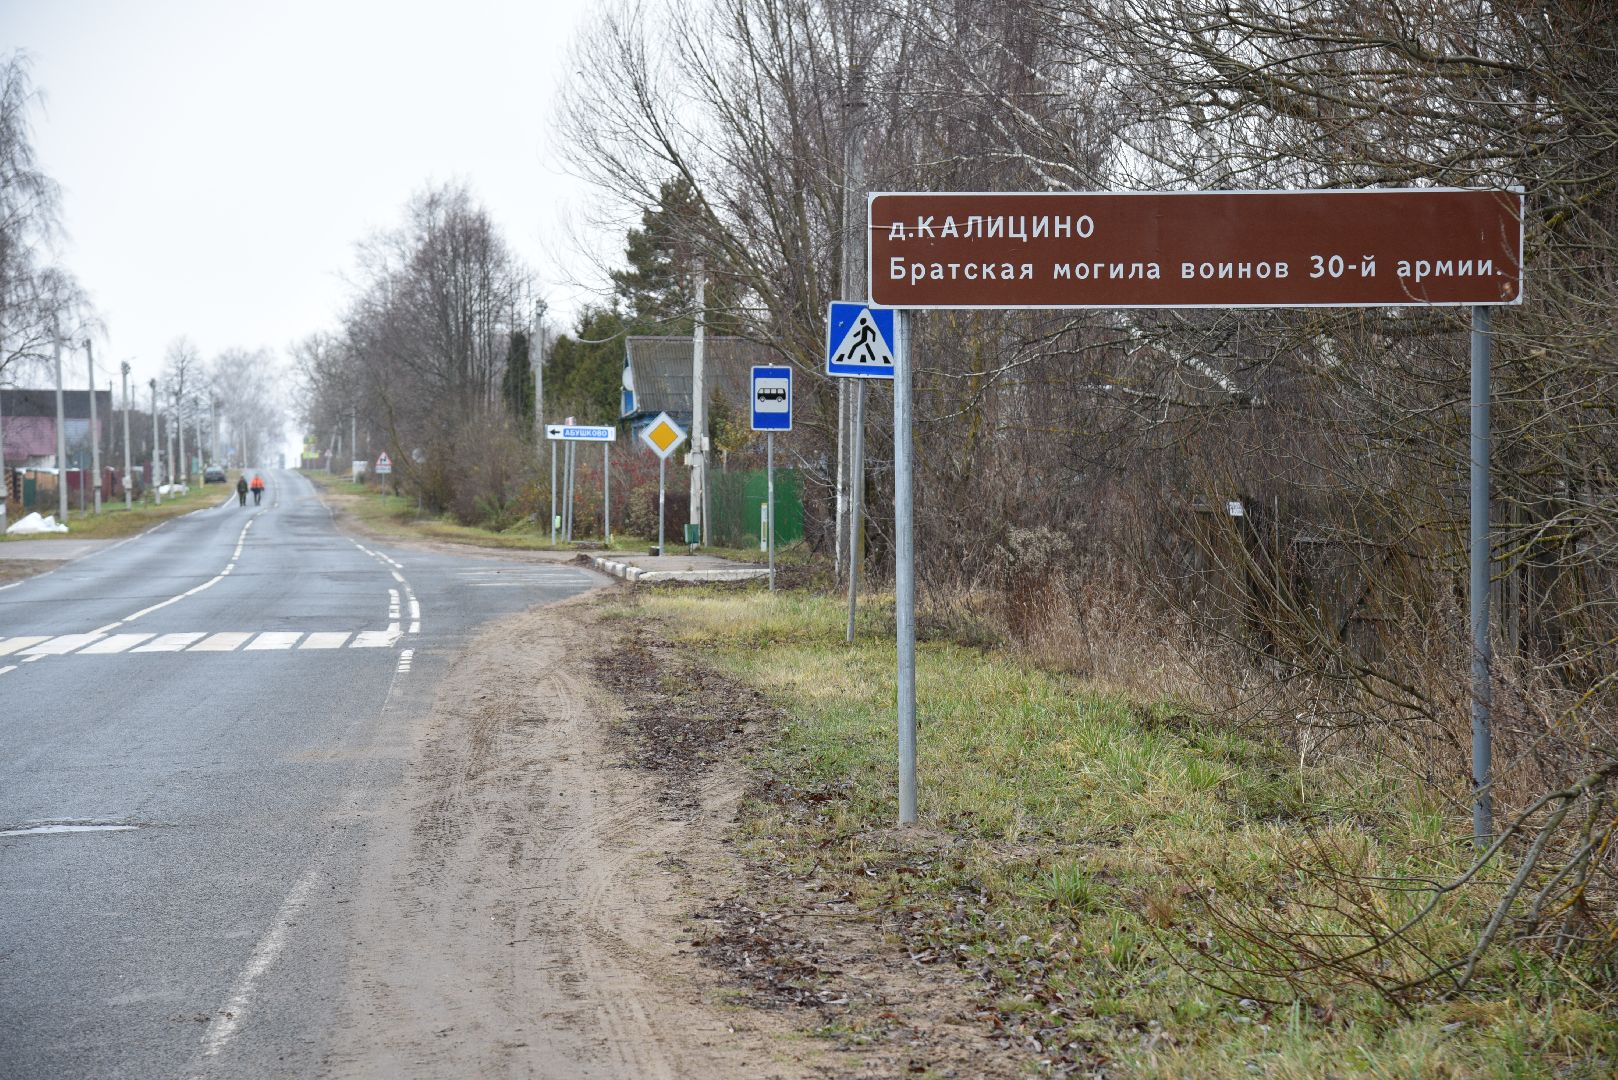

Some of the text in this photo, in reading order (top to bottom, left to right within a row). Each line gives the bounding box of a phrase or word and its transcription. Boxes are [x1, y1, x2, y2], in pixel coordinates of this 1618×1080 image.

[888, 214, 1095, 243] д.КАЛИЦИНО
[890, 254, 1503, 286] Братская могила воинов 30-й армии.
[564, 429, 608, 437] АБУШКОВО
